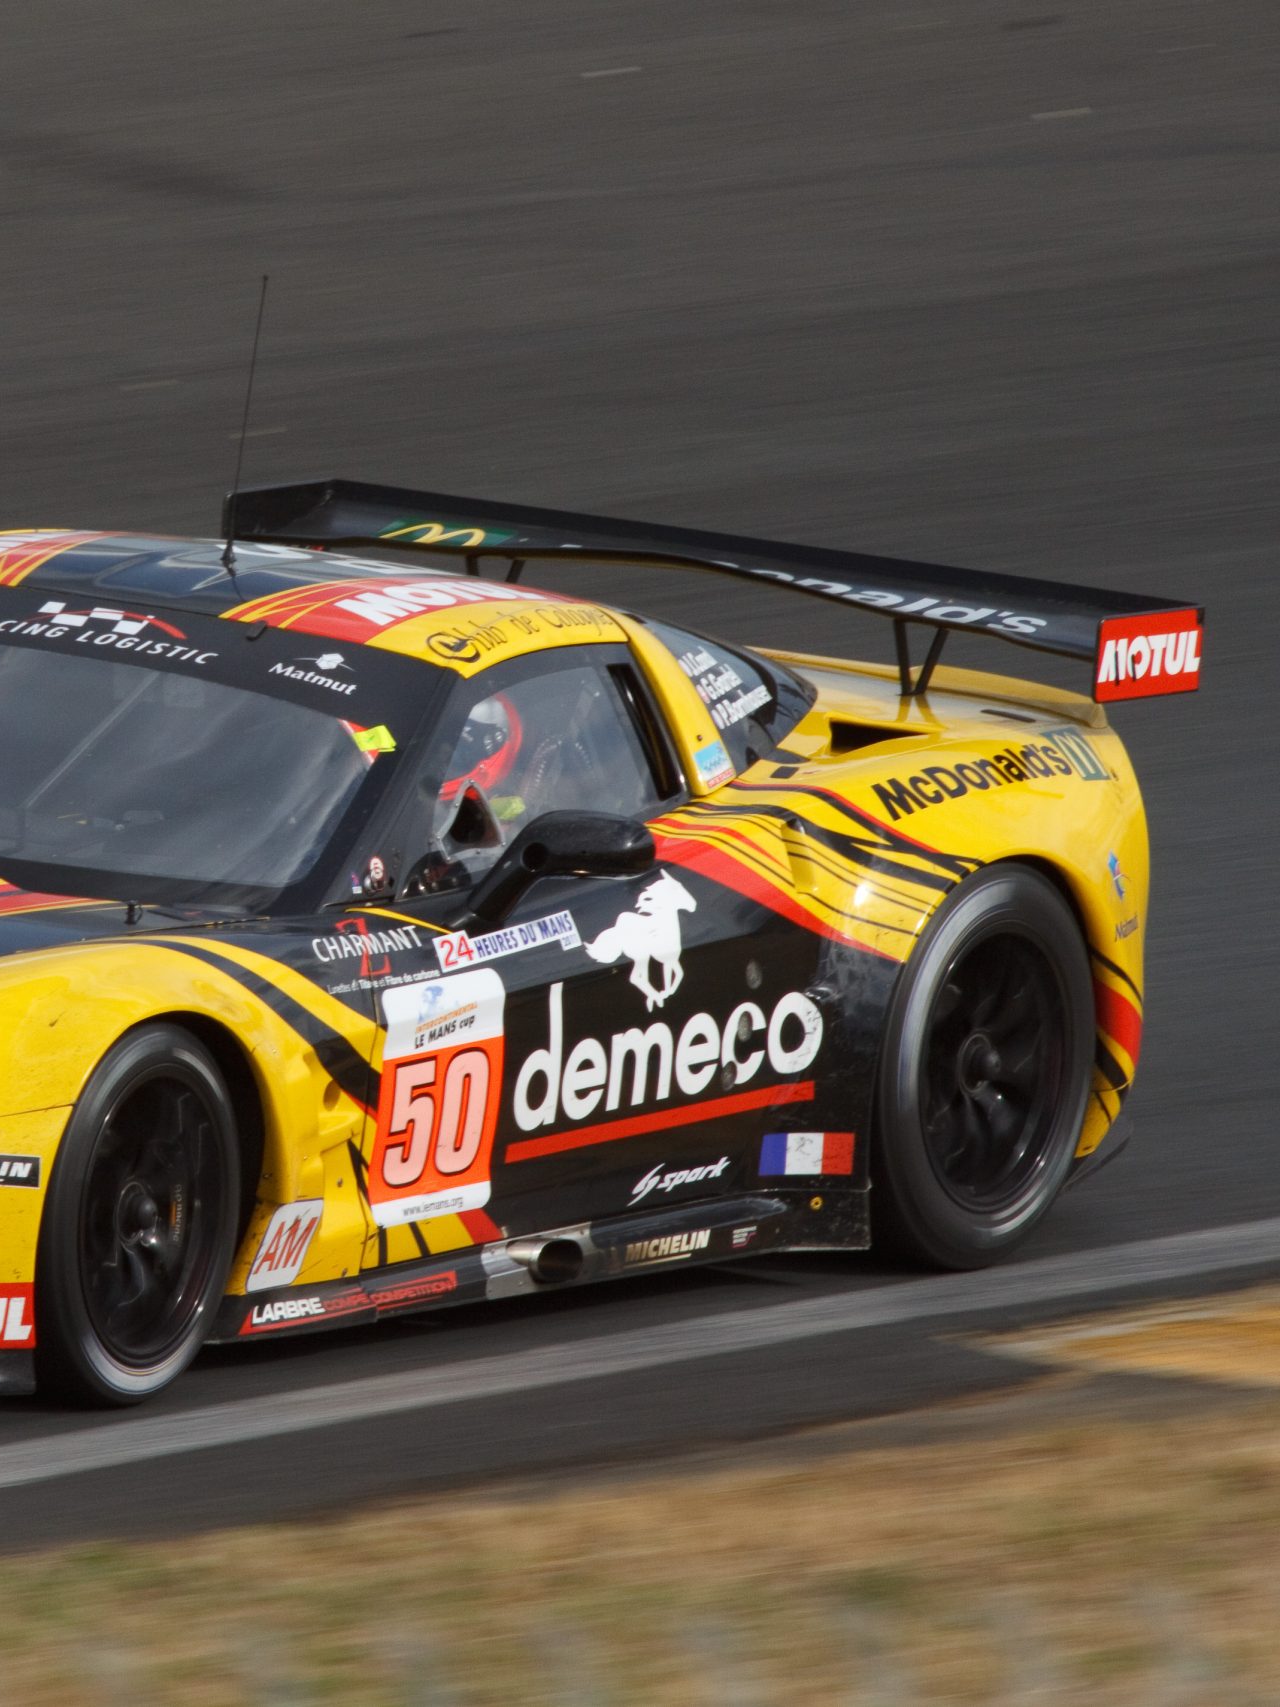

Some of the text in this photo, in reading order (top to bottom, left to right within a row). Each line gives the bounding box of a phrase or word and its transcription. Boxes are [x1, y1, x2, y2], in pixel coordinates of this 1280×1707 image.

[334, 581, 548, 626] MOTUL
[75, 630, 219, 665] LOGISTIC
[1098, 630, 1201, 684] MOTUL
[269, 661, 357, 696] Matmut
[872, 743, 1072, 821] McDonald's
[312, 925, 423, 963] CHARMANT
[438, 911, 574, 967] 24 HEURES DU MANS
[415, 1015, 476, 1049] LE MANS cup
[513, 983, 824, 1132] demeco
[382, 1047, 490, 1189] 50
[253, 1216, 318, 1276] AM
[624, 1229, 711, 1263] MICHELIN
[251, 1296, 326, 1325] LARBRE
